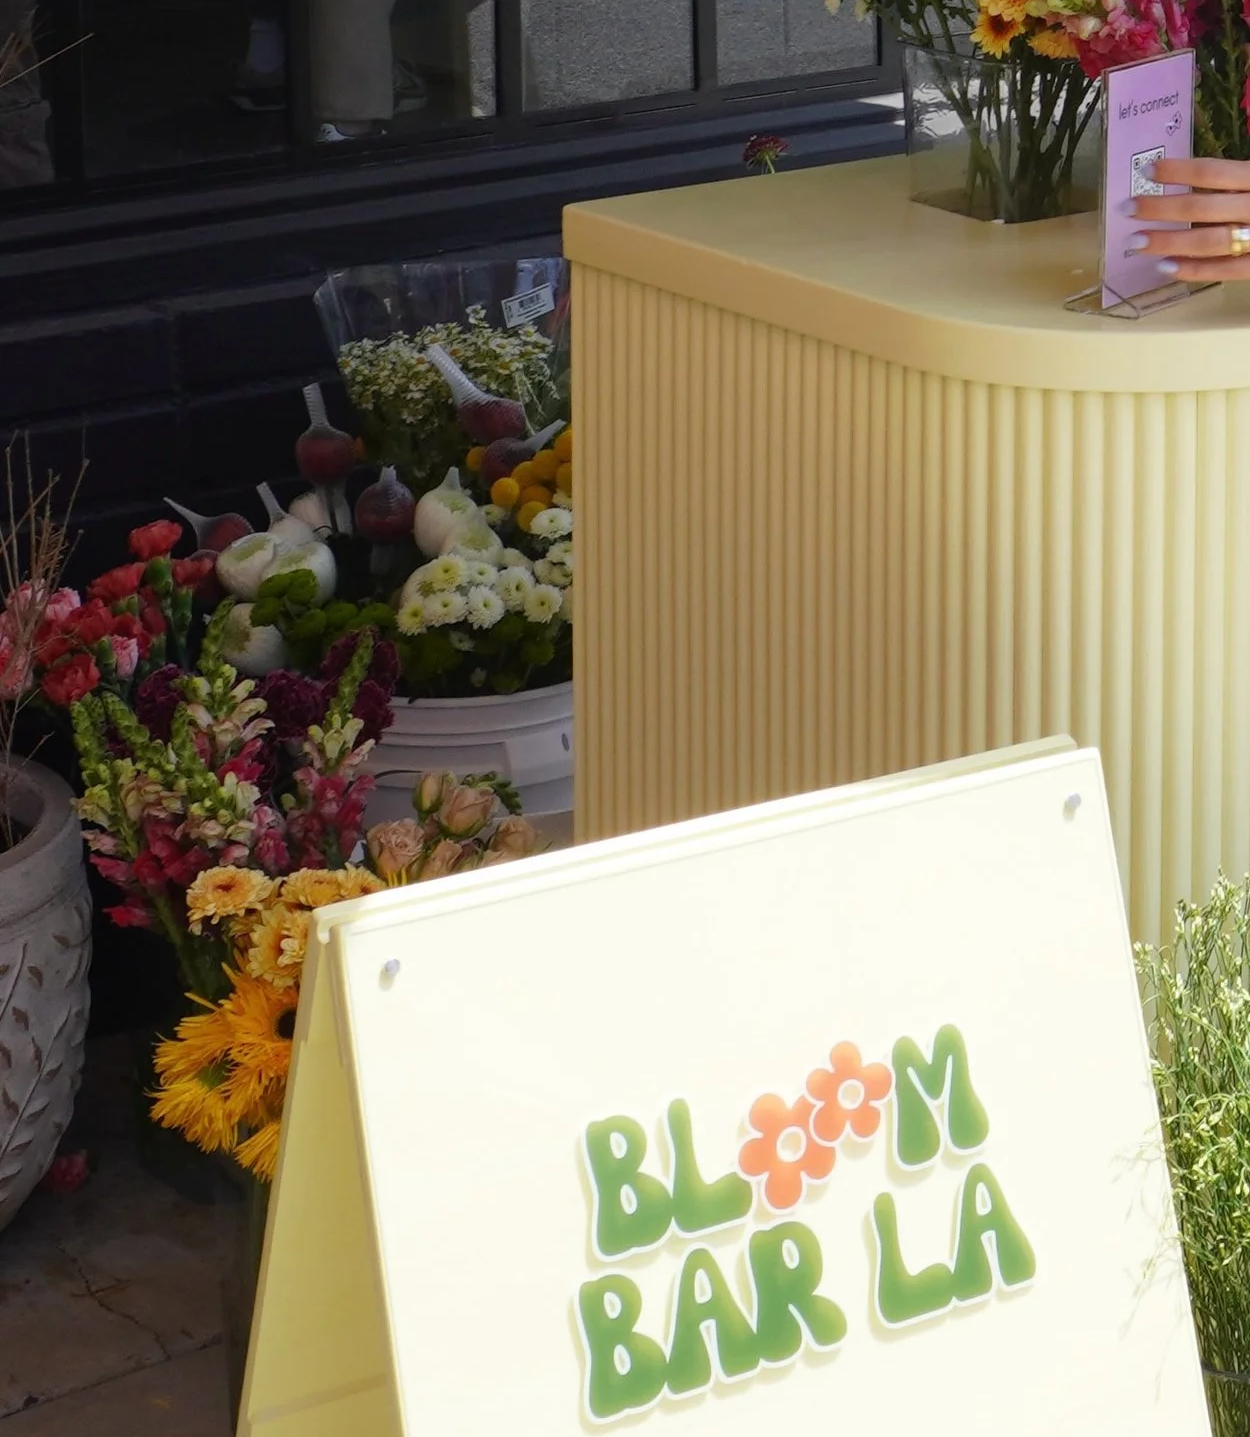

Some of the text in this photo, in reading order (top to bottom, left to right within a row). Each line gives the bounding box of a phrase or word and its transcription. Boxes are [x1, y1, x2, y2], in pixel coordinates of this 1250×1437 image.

[1118, 90, 1179, 120] let's connect
[584, 1022, 989, 1256] BLOOM
[577, 1162, 1037, 1419] BAR LA
